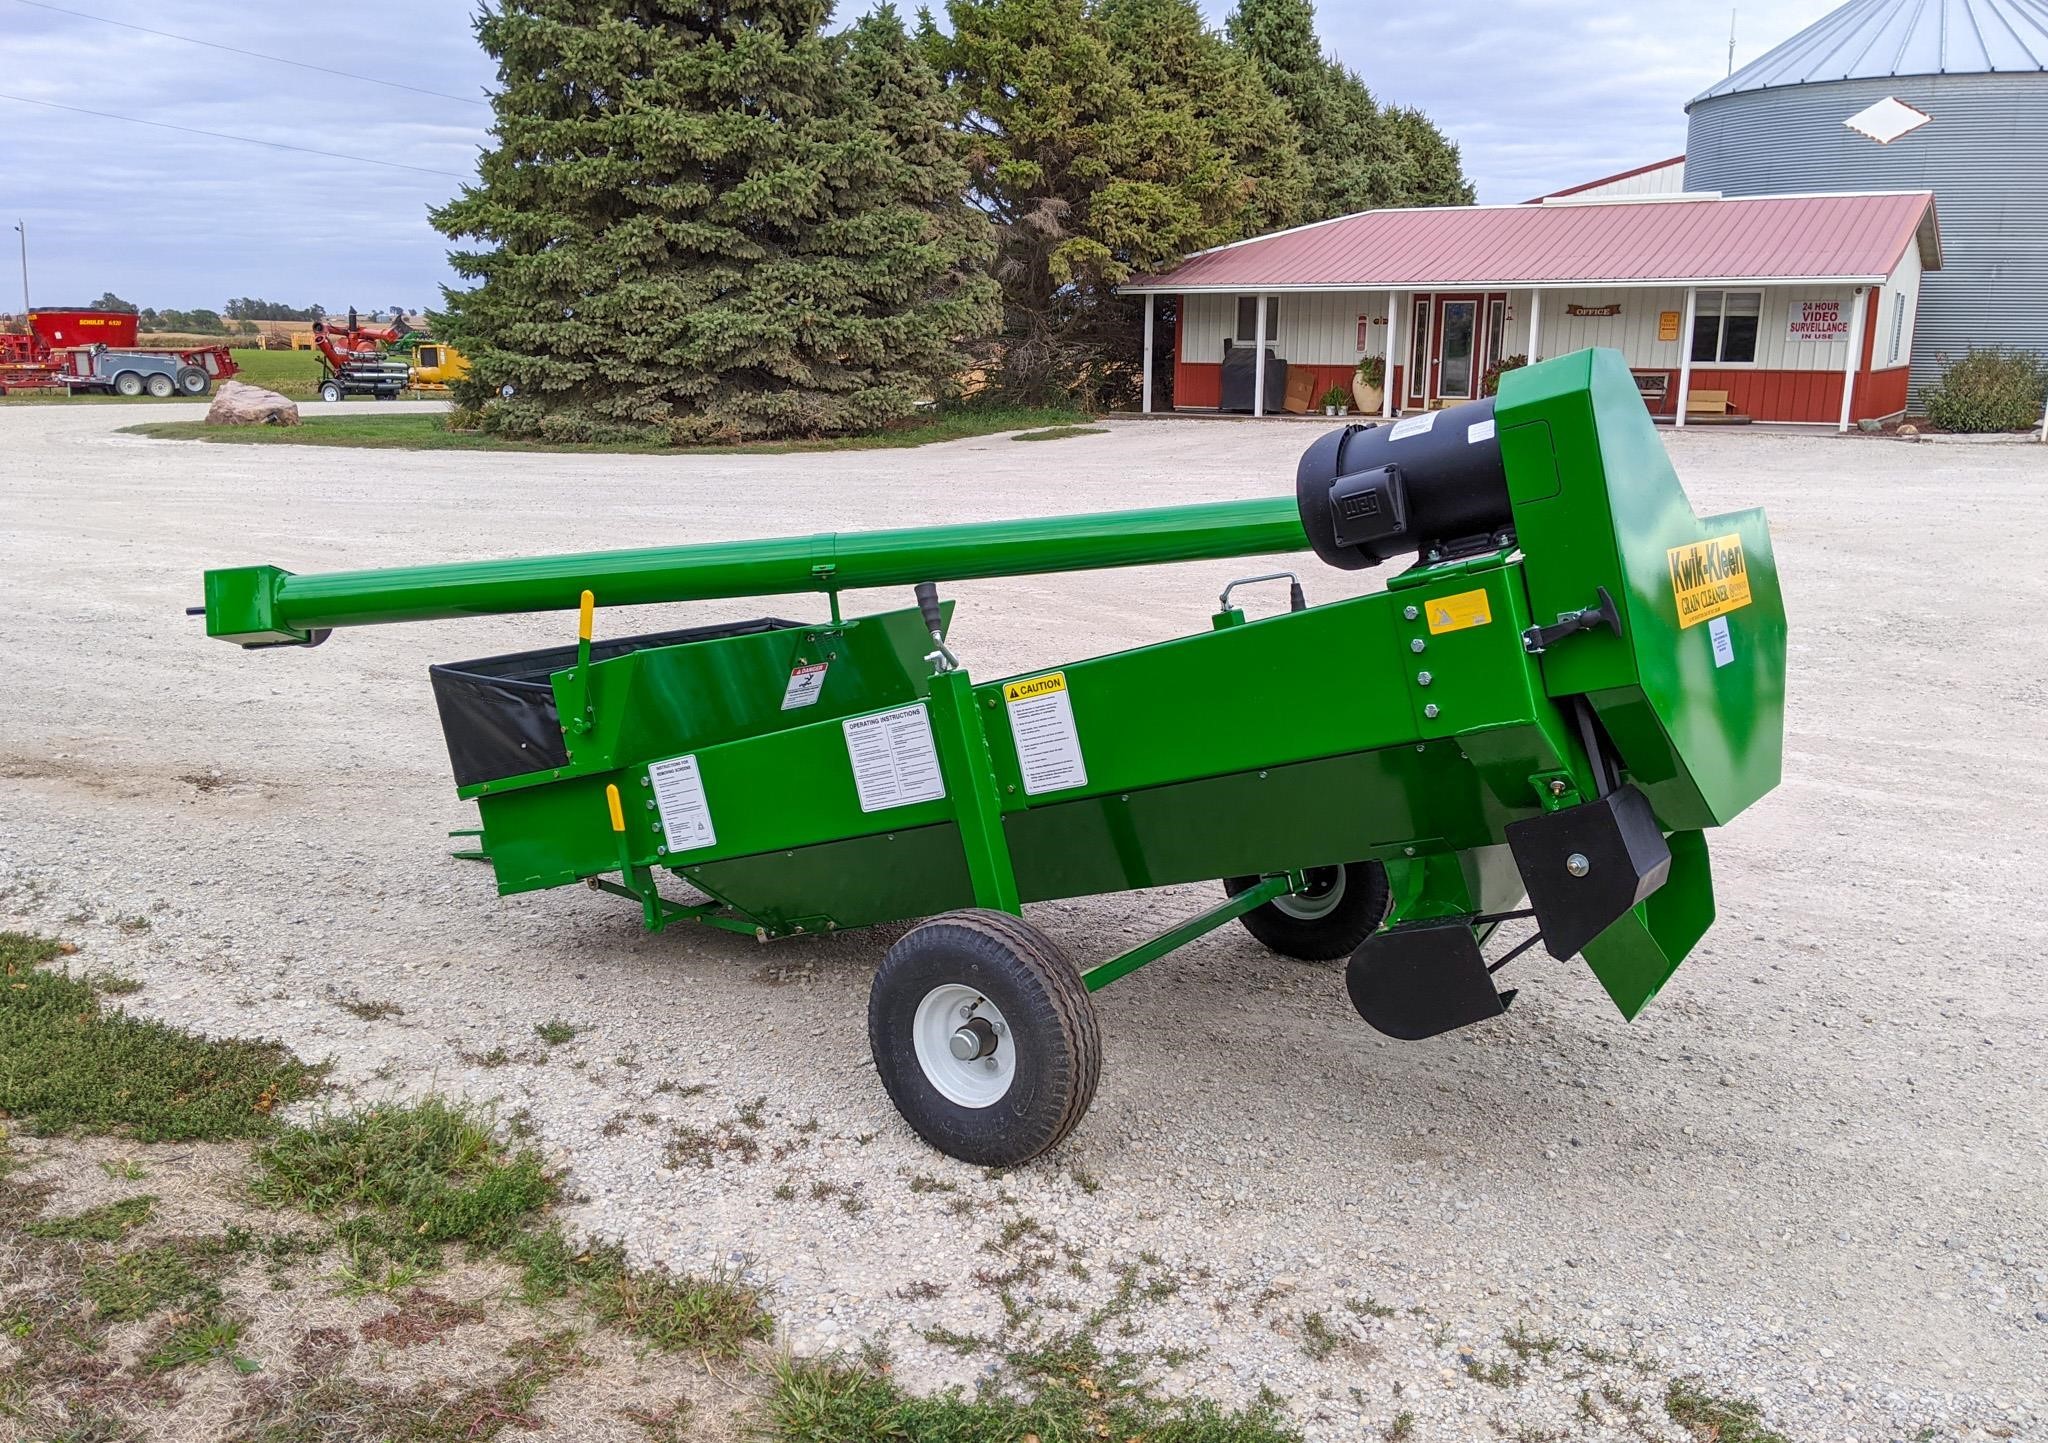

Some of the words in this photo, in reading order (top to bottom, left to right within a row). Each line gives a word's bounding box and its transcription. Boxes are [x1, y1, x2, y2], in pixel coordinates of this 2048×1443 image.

[1802, 302, 1813, 311] 24
[1814, 302, 1840, 311] HOUR
[1802, 311, 1838, 322] VIDEO
[1790, 322, 1848, 332] SURVEILLANCE
[1671, 542, 1744, 593] Kwik-Kleen
[1681, 593, 1701, 616] GRAIN
[1700, 584, 1729, 609] CLEANER
[1020, 678, 1061, 695] CAUTION
[849, 718, 880, 730] OPERATING
[880, 708, 921, 723] INSTRUCTIONS
